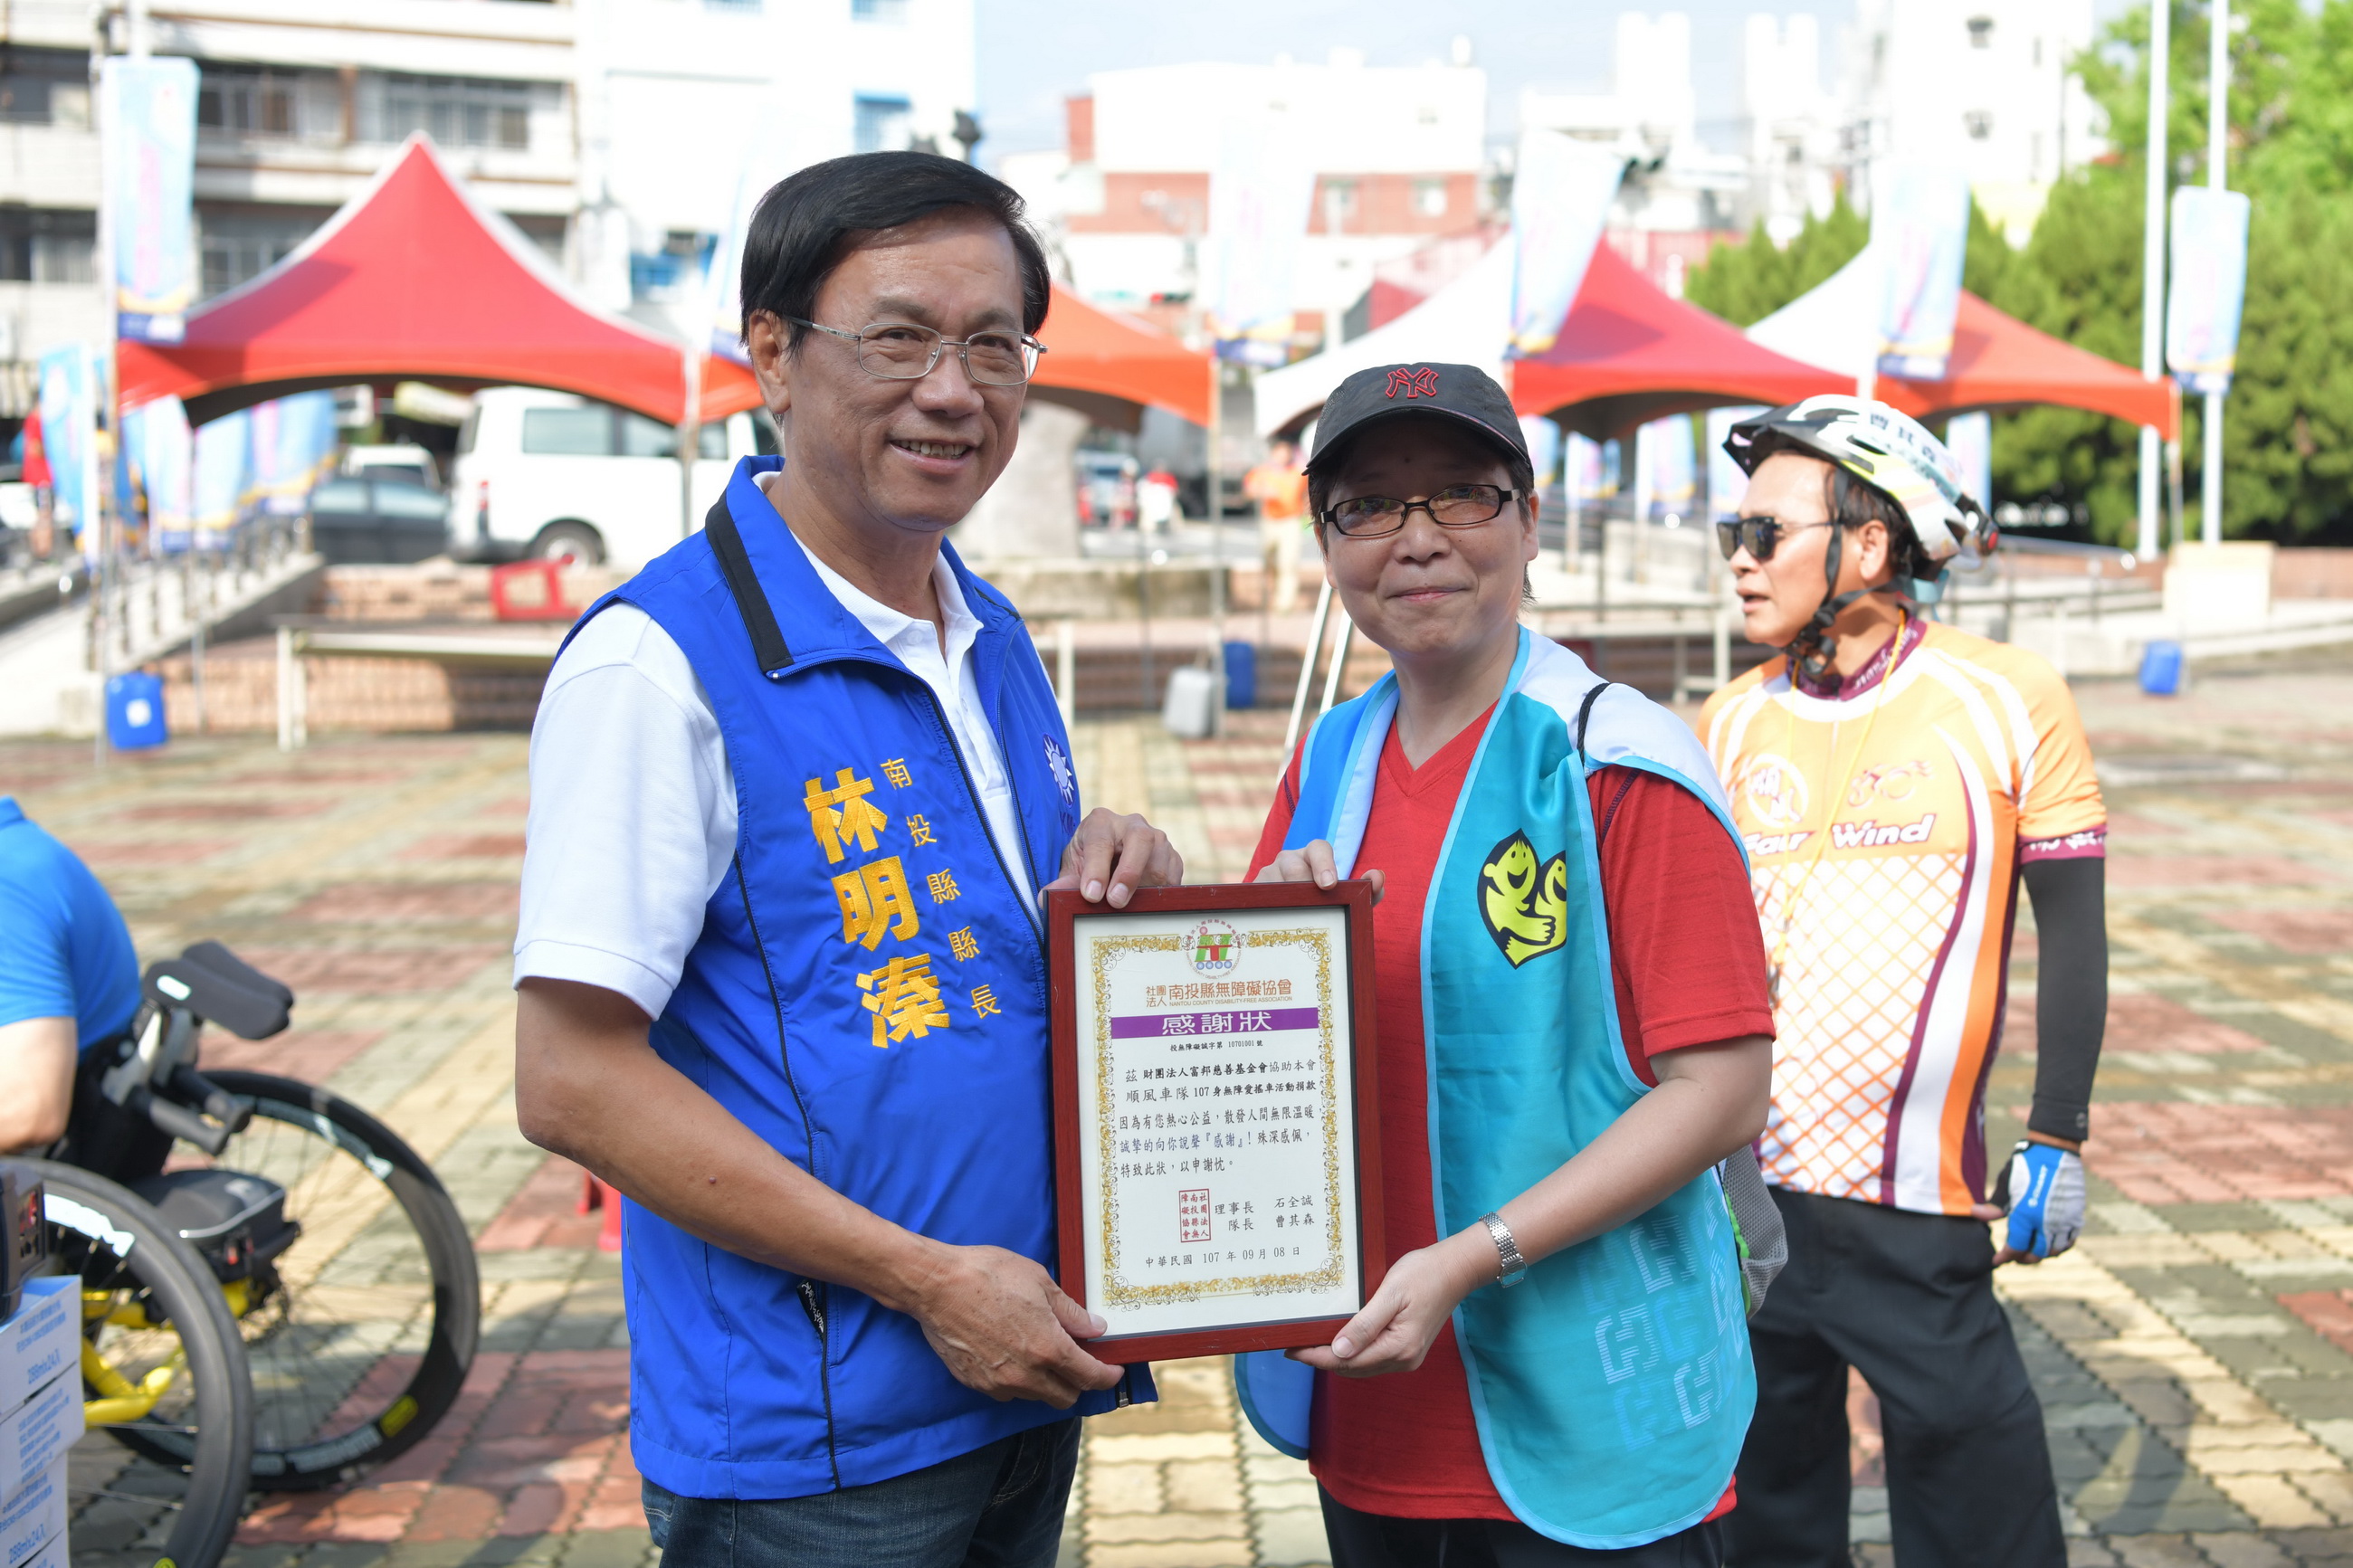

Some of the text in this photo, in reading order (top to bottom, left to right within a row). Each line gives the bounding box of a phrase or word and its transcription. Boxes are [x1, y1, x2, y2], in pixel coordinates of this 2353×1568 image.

[1385, 366, 1439, 399] NY
[1831, 813, 1938, 851] Wind
[880, 757, 1002, 1020] 南投縣縣長
[803, 766, 950, 1050] 林明溱
[1168, 978, 1292, 1001] 南投縣無障礙協會
[1192, 998, 1214, 1006] COUNTY
[1258, 995, 1293, 1003] ASSOCIATION
[1161, 1011, 1273, 1036] 感謝狀
[1214, 1194, 1314, 1215] 理事長 石全誠
[1228, 1212, 1315, 1232] 隊長 曹其森
[1145, 1254, 1194, 1269] 中華民國
